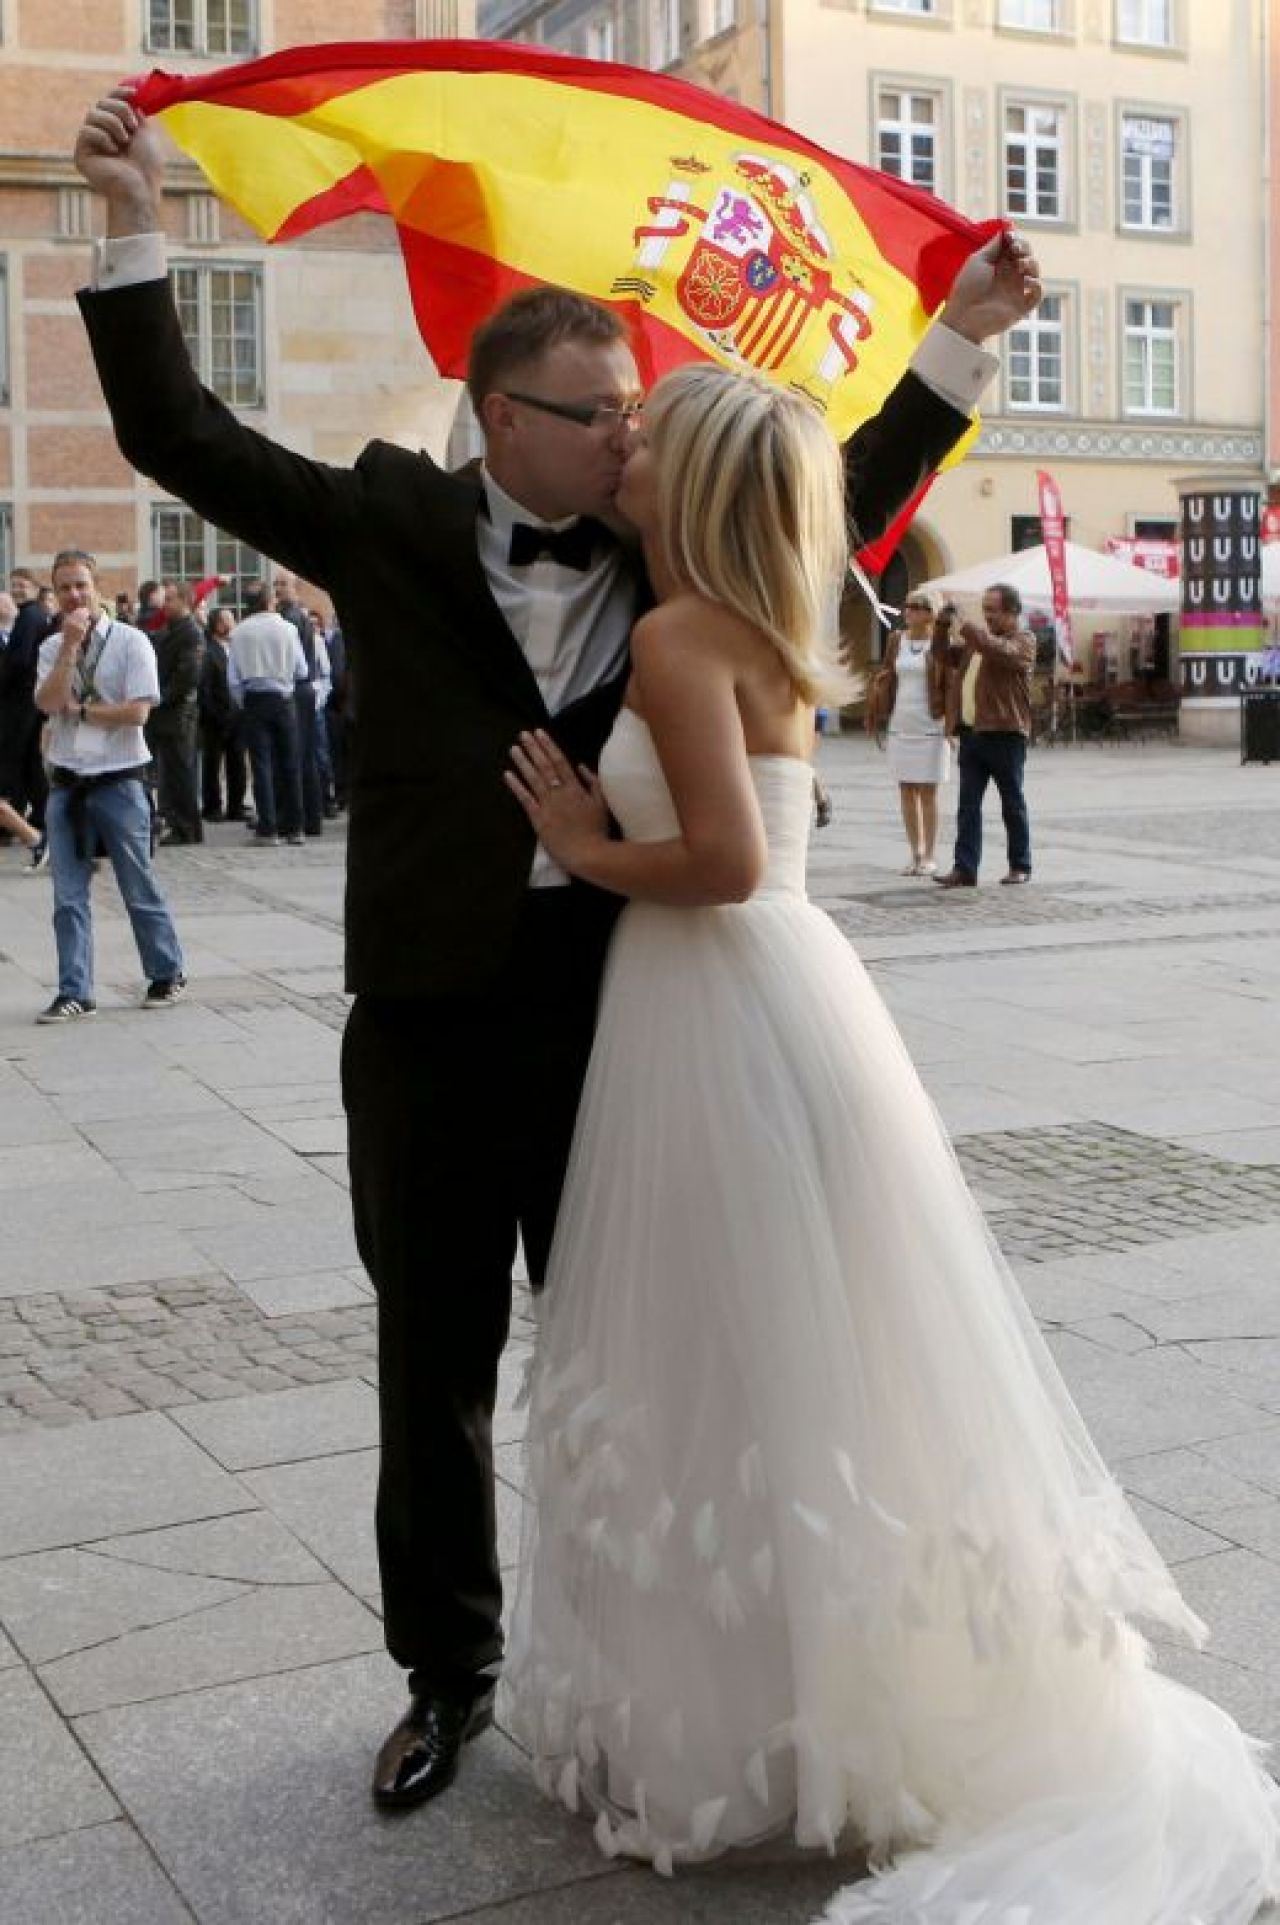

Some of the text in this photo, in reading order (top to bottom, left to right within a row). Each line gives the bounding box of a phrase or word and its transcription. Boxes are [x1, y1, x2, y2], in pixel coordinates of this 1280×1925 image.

[1189, 496, 1254, 521] U U U
[1190, 538, 1204, 561] U
[1214, 537, 1231, 561] U
[1242, 536, 1255, 560] U
[1189, 578, 1253, 603] U U U
[1191, 661, 1206, 685] U
[1216, 661, 1234, 684] U
